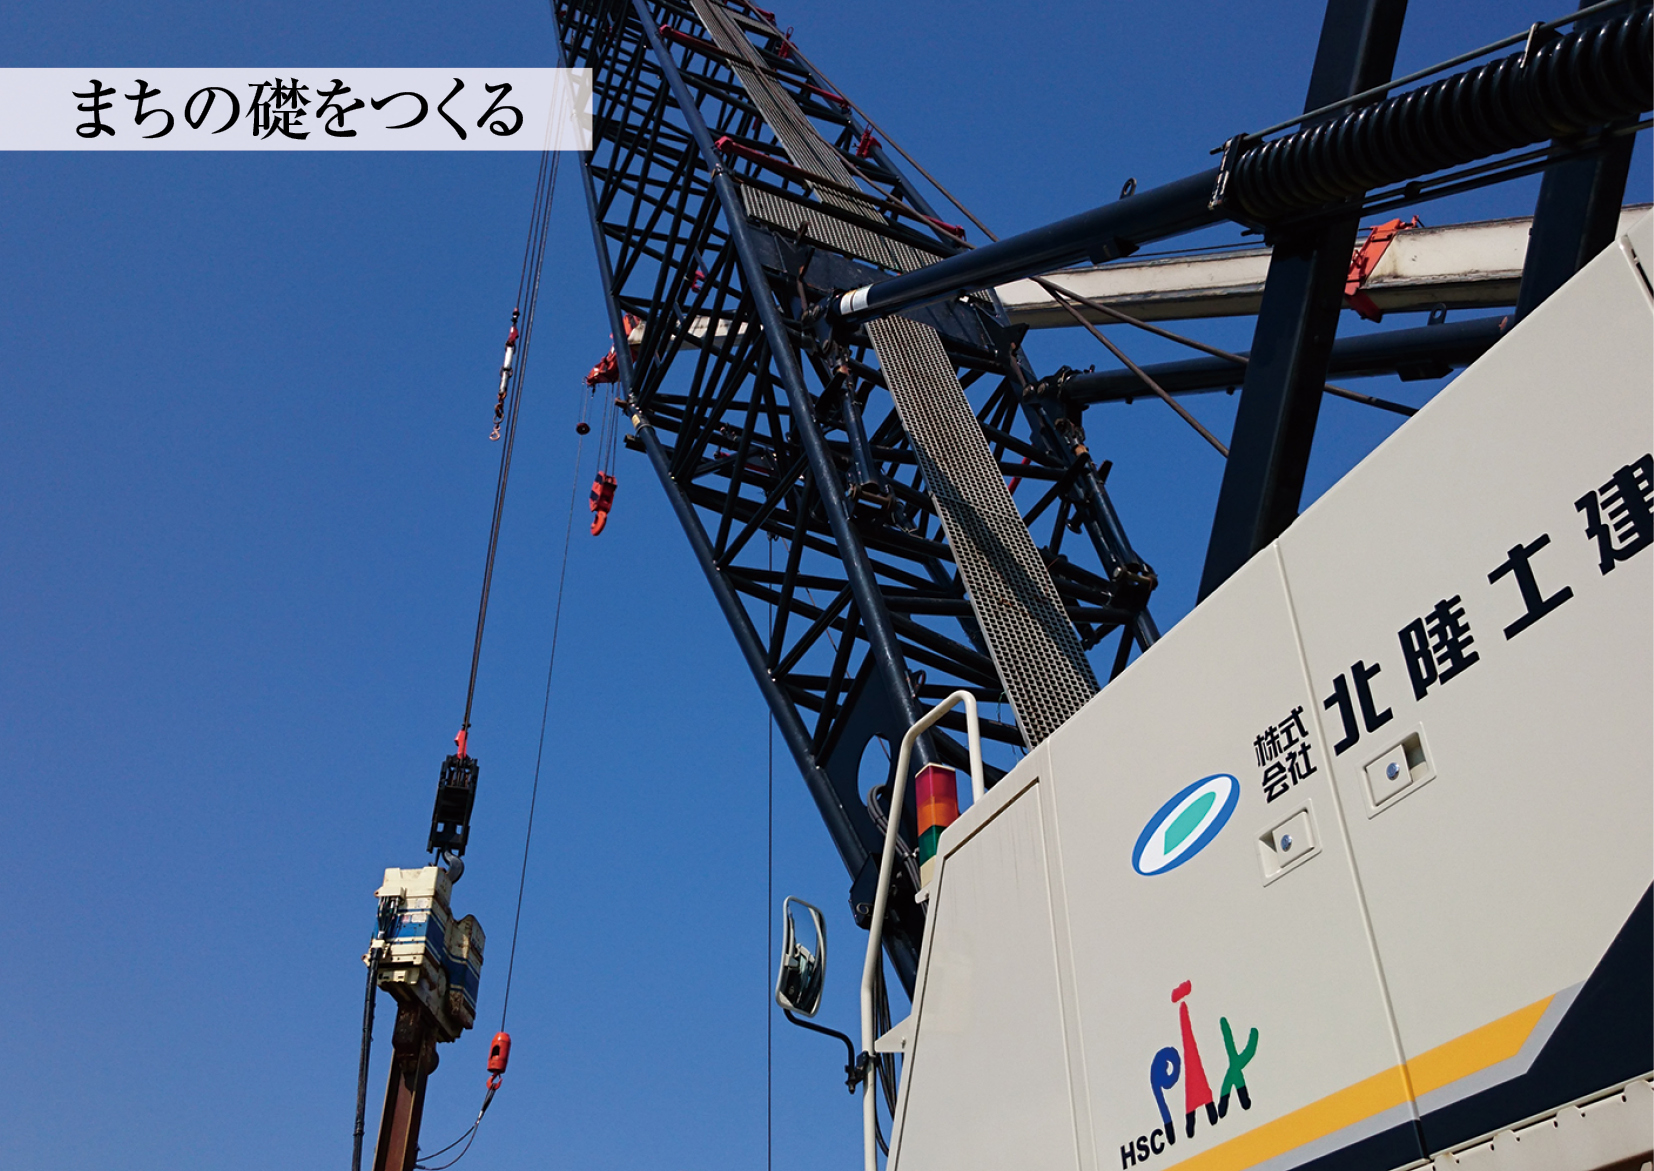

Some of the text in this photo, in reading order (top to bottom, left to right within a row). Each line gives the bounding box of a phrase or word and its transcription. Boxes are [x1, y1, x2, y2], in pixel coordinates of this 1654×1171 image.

[1323, 453, 1654, 756] 北陸土建
[1253, 705, 1309, 767] 株式
[1262, 742, 1317, 803] 会社
[1120, 1128, 1165, 1170] HSC
